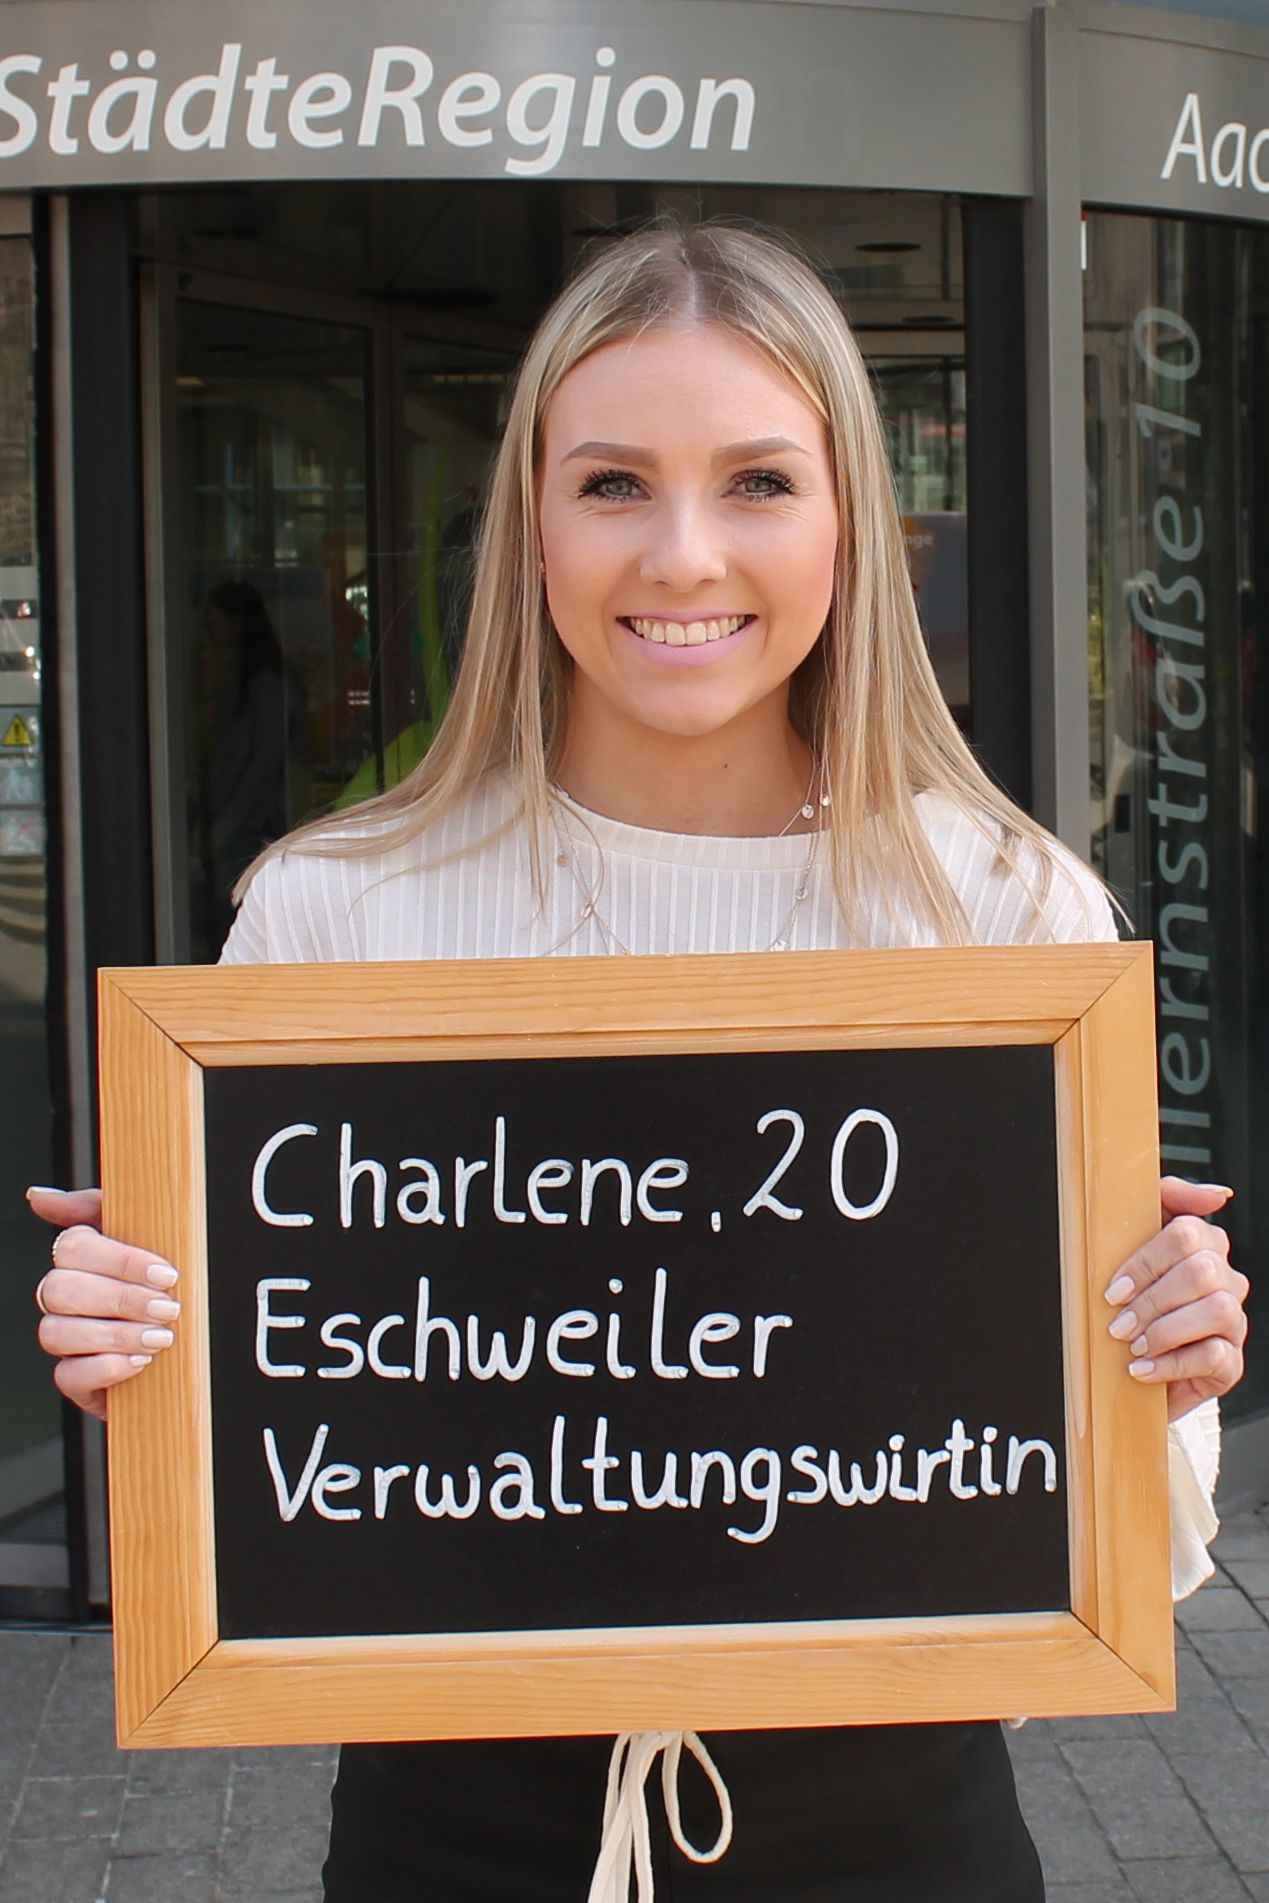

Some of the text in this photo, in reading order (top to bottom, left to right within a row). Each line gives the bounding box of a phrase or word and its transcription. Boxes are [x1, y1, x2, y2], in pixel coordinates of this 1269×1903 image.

[0, 43, 756, 176] StädteRegion
[1130, 306, 1211, 1184] llernstraße 10
[742, 1108, 900, 1221] 20
[255, 1267, 794, 1382] Eschweiler
[263, 1415, 1057, 1544] Verwaltungswirtin
